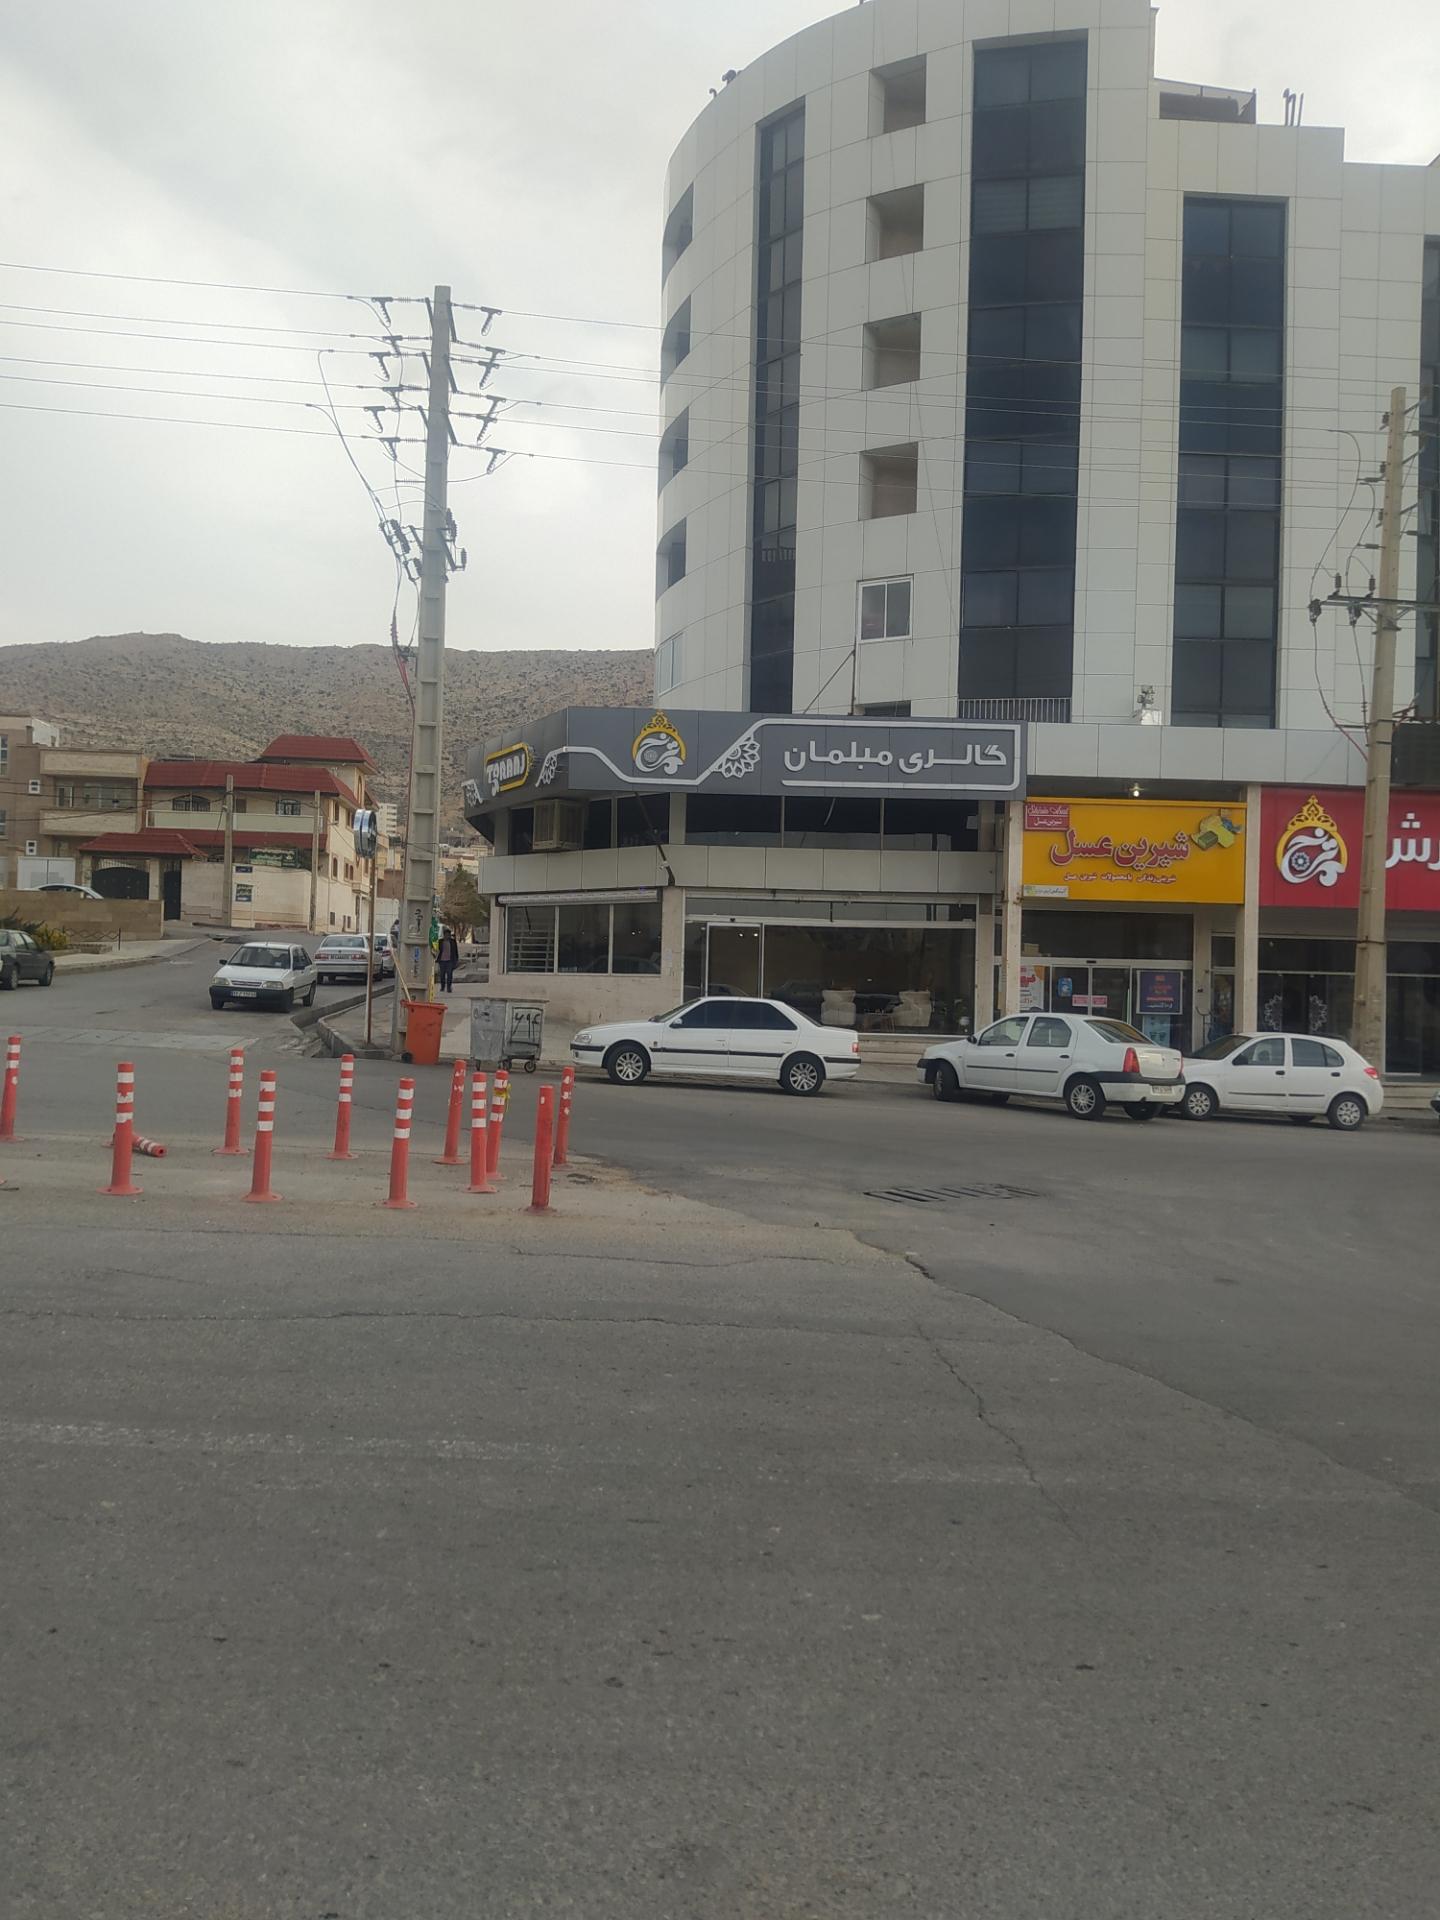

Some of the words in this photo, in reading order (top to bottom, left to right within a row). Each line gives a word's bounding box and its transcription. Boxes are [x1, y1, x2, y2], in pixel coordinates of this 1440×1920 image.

[783, 740, 893, 772] مبلمان
[1050, 827, 1114, 866] عسل
[1113, 831, 1191, 870] شیرین
